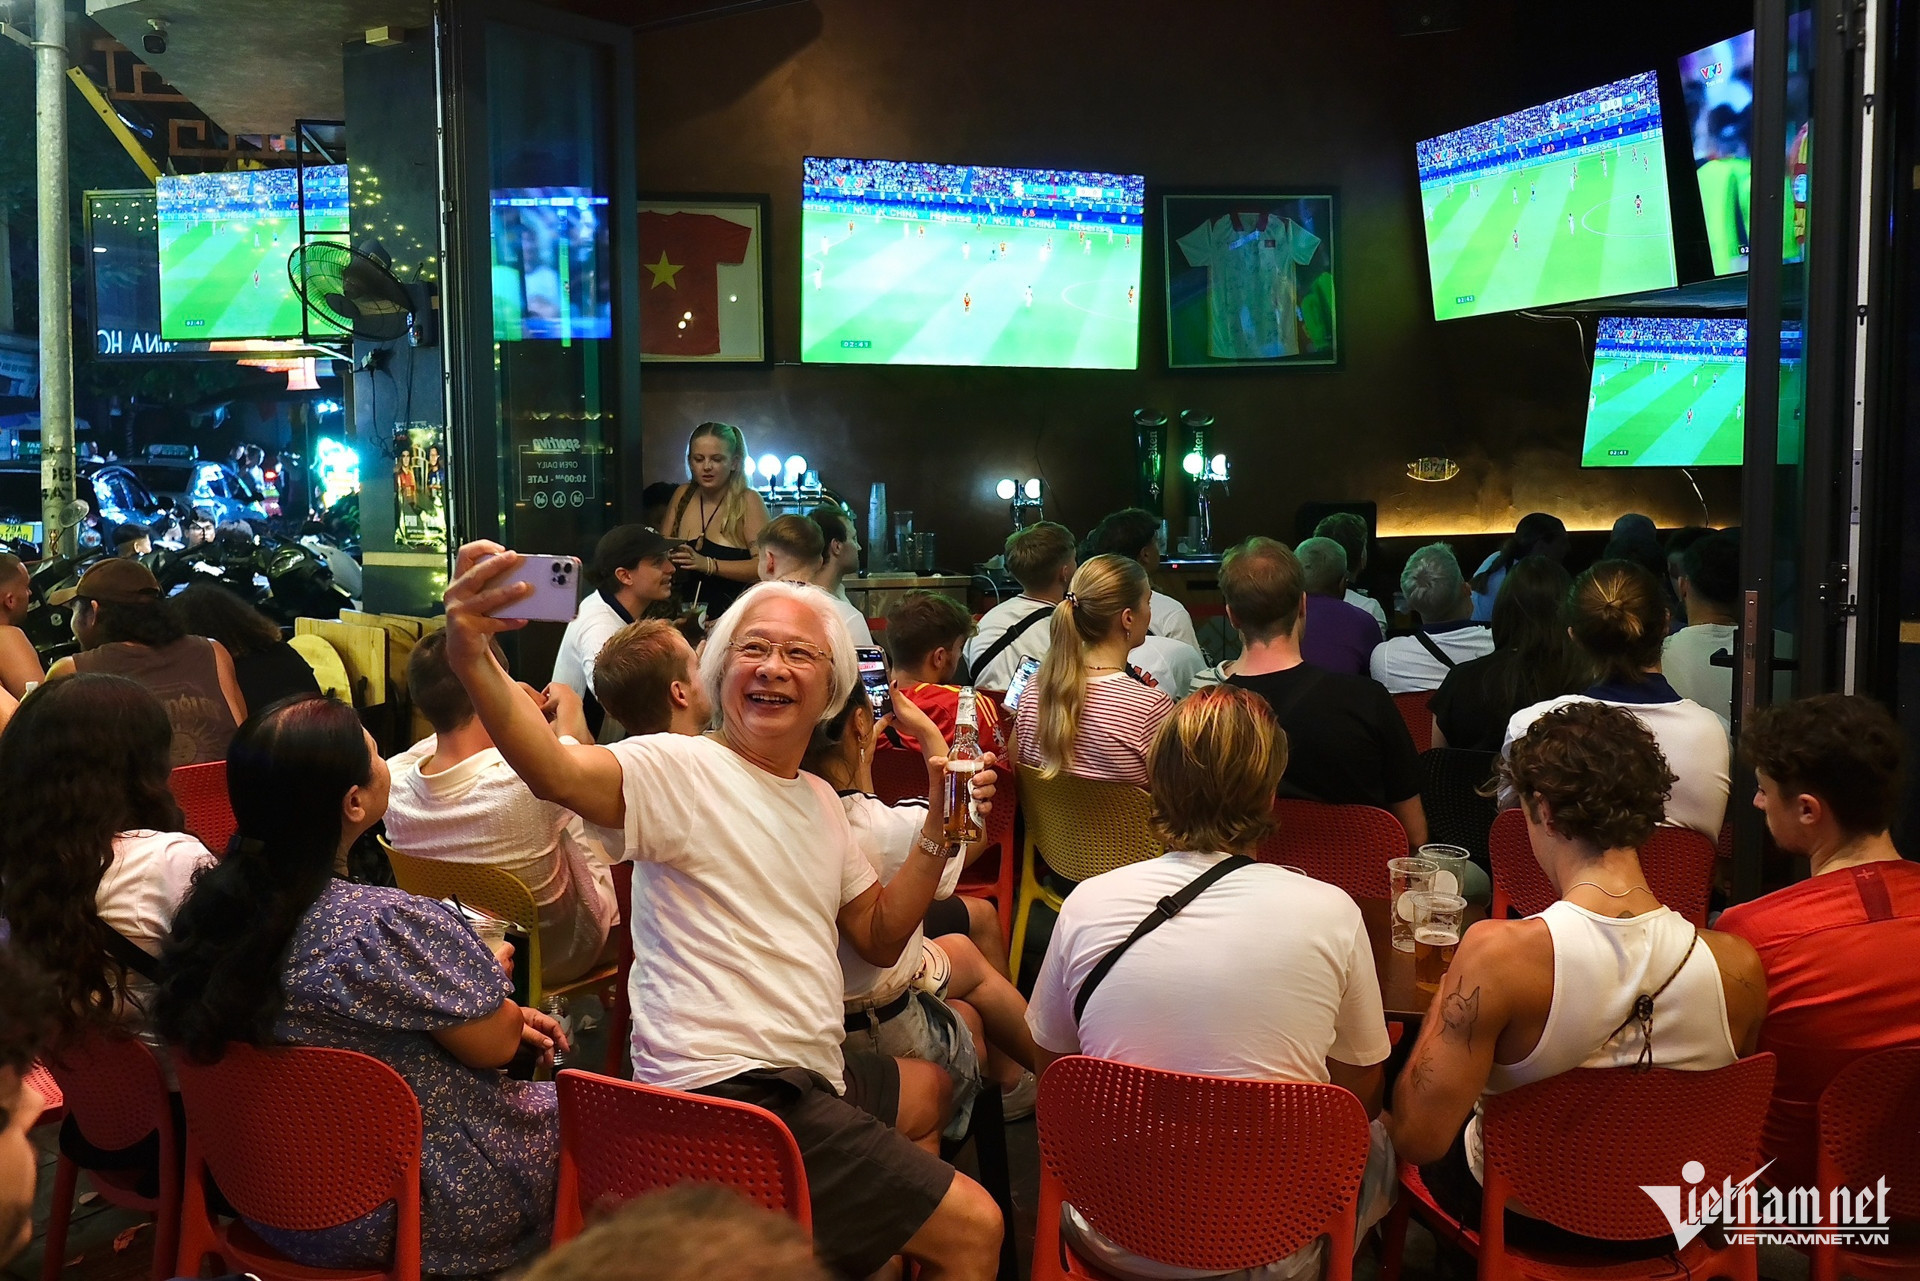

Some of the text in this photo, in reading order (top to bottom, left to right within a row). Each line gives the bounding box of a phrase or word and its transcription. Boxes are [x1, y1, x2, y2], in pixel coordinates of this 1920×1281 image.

[1578, 141, 1612, 155] Hisense
[890, 209, 919, 219] CHINA
[1028, 219, 1057, 229] CHINA
